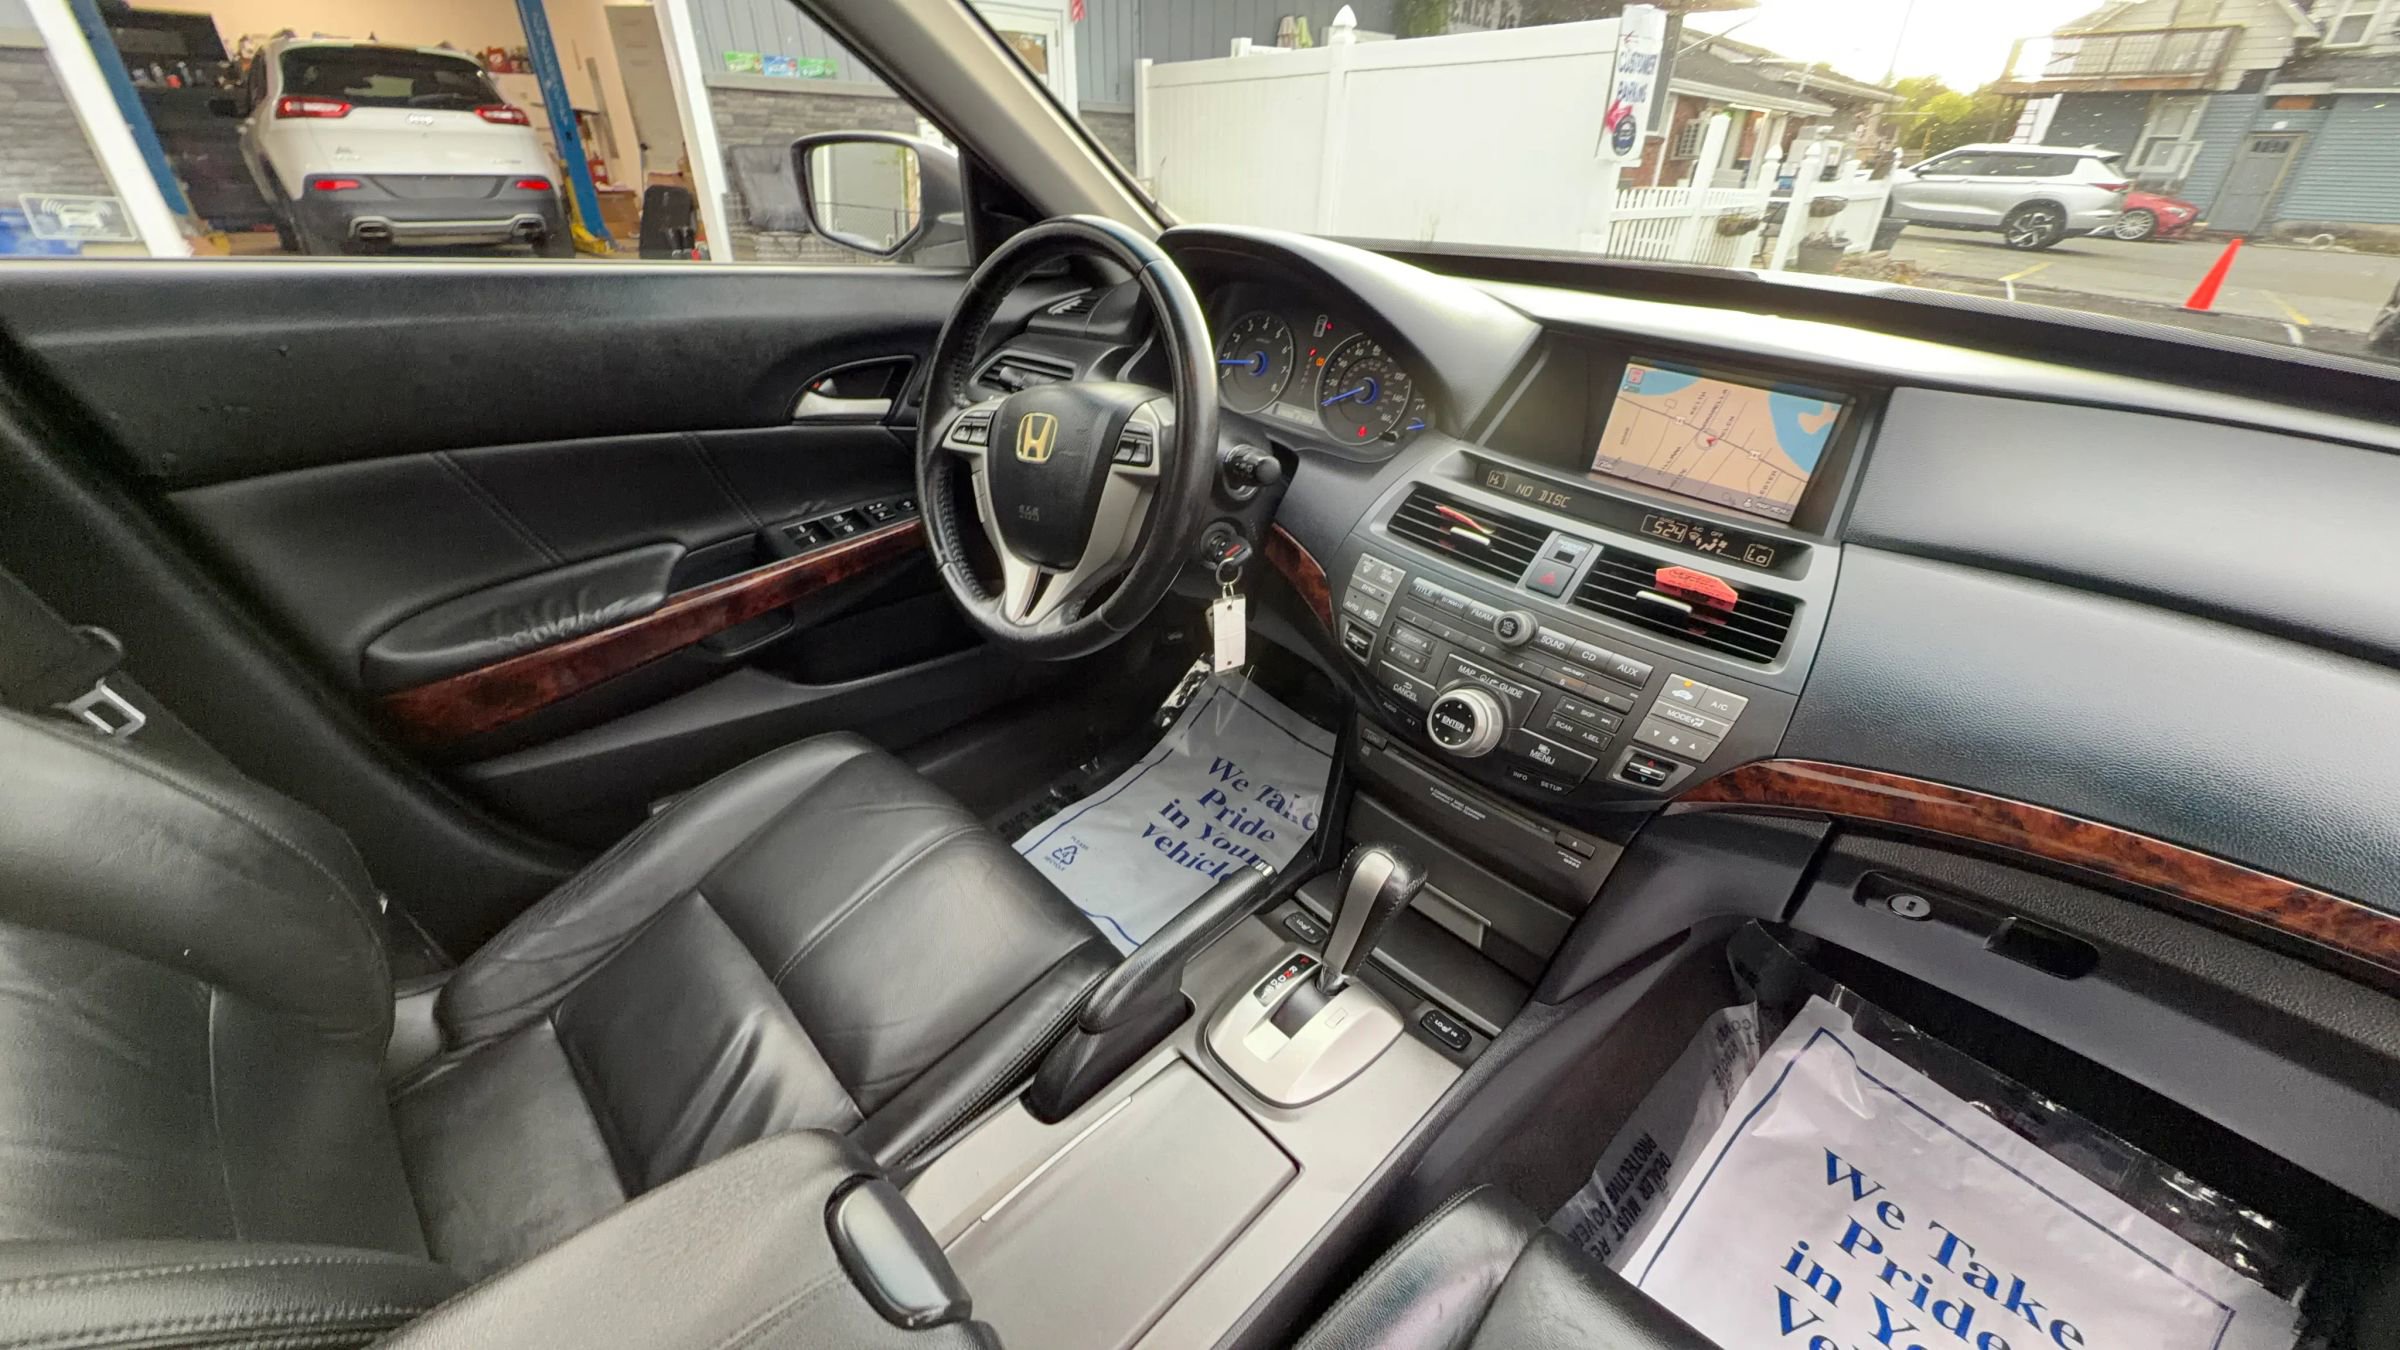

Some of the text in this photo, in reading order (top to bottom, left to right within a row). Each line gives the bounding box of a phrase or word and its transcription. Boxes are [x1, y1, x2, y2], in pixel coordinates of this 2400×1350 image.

[1515, 483, 1571, 508] NO DISC
[1415, 584, 1434, 598] TITLE
[1541, 635, 1566, 650] SOUND
[1581, 651, 1597, 662] CD
[1458, 665, 1476, 676] MAP
[1617, 663, 1639, 677] AUX
[1393, 683, 1417, 702] CANCEL
[1499, 683, 1524, 699] GUIDE
[1710, 701, 1729, 711] A/C
[1441, 715, 1466, 733] ENTER
[1666, 709, 1692, 723] MODE
[1555, 721, 1574, 732] SCAN
[1529, 748, 1556, 766] MENU
[1208, 756, 1249, 792] We
[1513, 771, 1528, 782] INFO
[1540, 781, 1563, 792] SETUP
[1159, 798, 1190, 830] in
[1198, 787, 1275, 843] Pride
[1605, 1132, 1658, 1206] PROTECTIVE
[1636, 1150, 1672, 1201] DEALER
[1612, 1196, 1642, 1241] MUST
[1823, 1146, 2085, 1350] We Take
[1780, 1240, 1843, 1309] in
[1833, 1214, 2012, 1350] Pride
